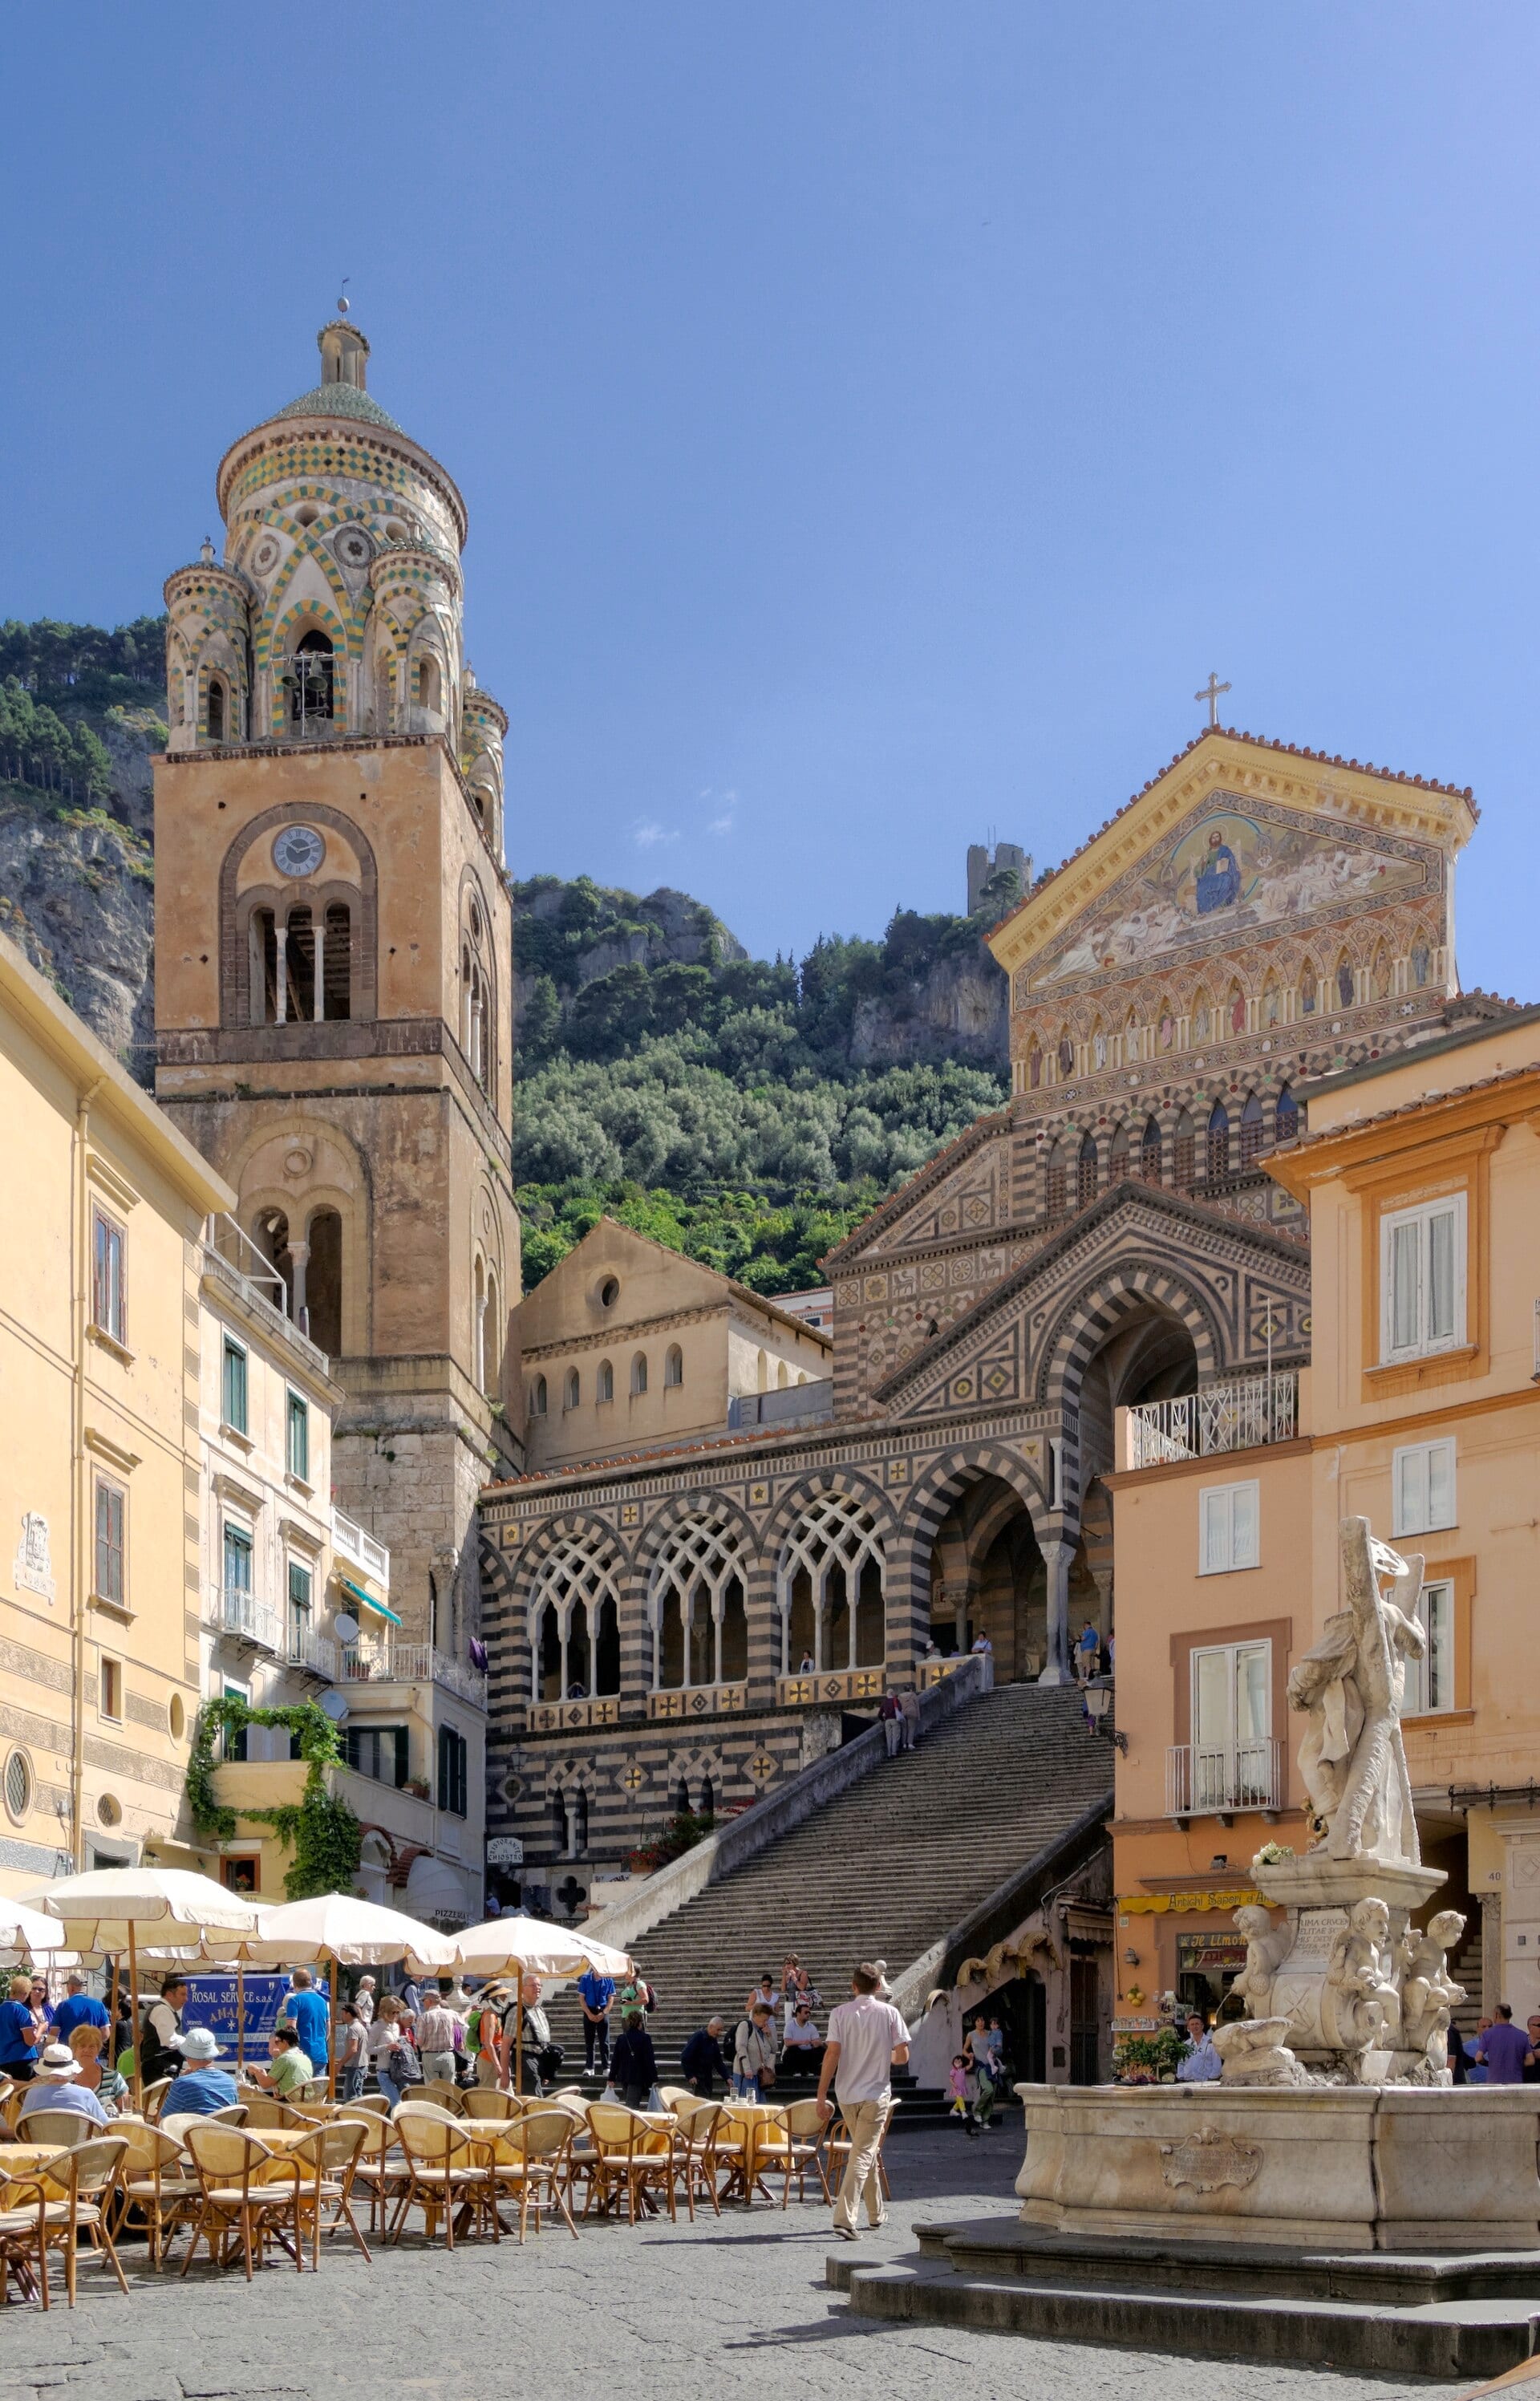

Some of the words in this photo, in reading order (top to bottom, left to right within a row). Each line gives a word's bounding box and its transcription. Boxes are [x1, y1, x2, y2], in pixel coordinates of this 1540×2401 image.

[490, 1839, 521, 1854] RISTORANTE
[1489, 1872, 1502, 1881] 40
[1169, 1894, 1202, 1908] Antichi
[1209, 1892, 1242, 1906] Sapori
[435, 1909, 467, 1920] PIZZERIA
[1190, 1934, 1206, 1947] Il
[192, 1991, 218, 2003] ROSAL
[221, 1991, 255, 2003] SERVCE
[255, 1994, 274, 2003] s.a.s.
